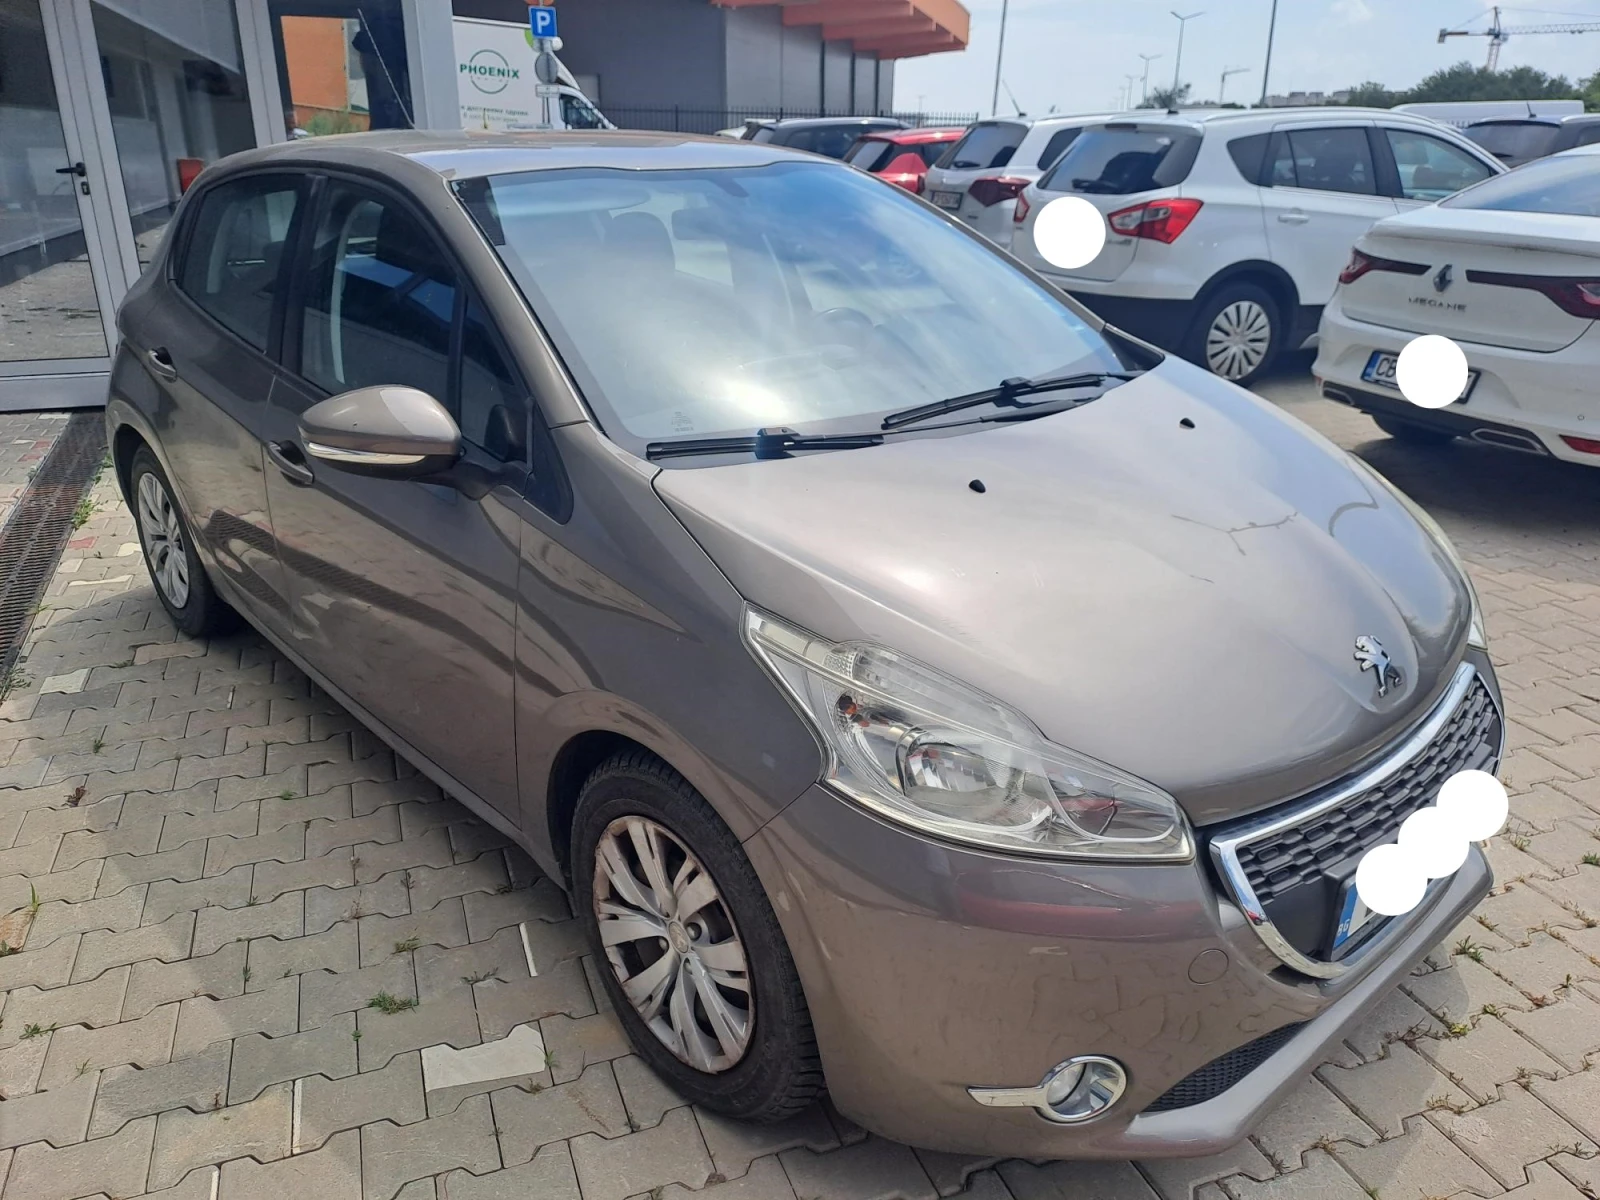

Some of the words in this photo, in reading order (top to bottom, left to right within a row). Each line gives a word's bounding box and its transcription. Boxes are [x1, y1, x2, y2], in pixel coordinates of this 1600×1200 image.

[536, 11, 551, 34] P
[460, 63, 520, 79] PHOENIX
[1408, 296, 1467, 312] MEGANE
